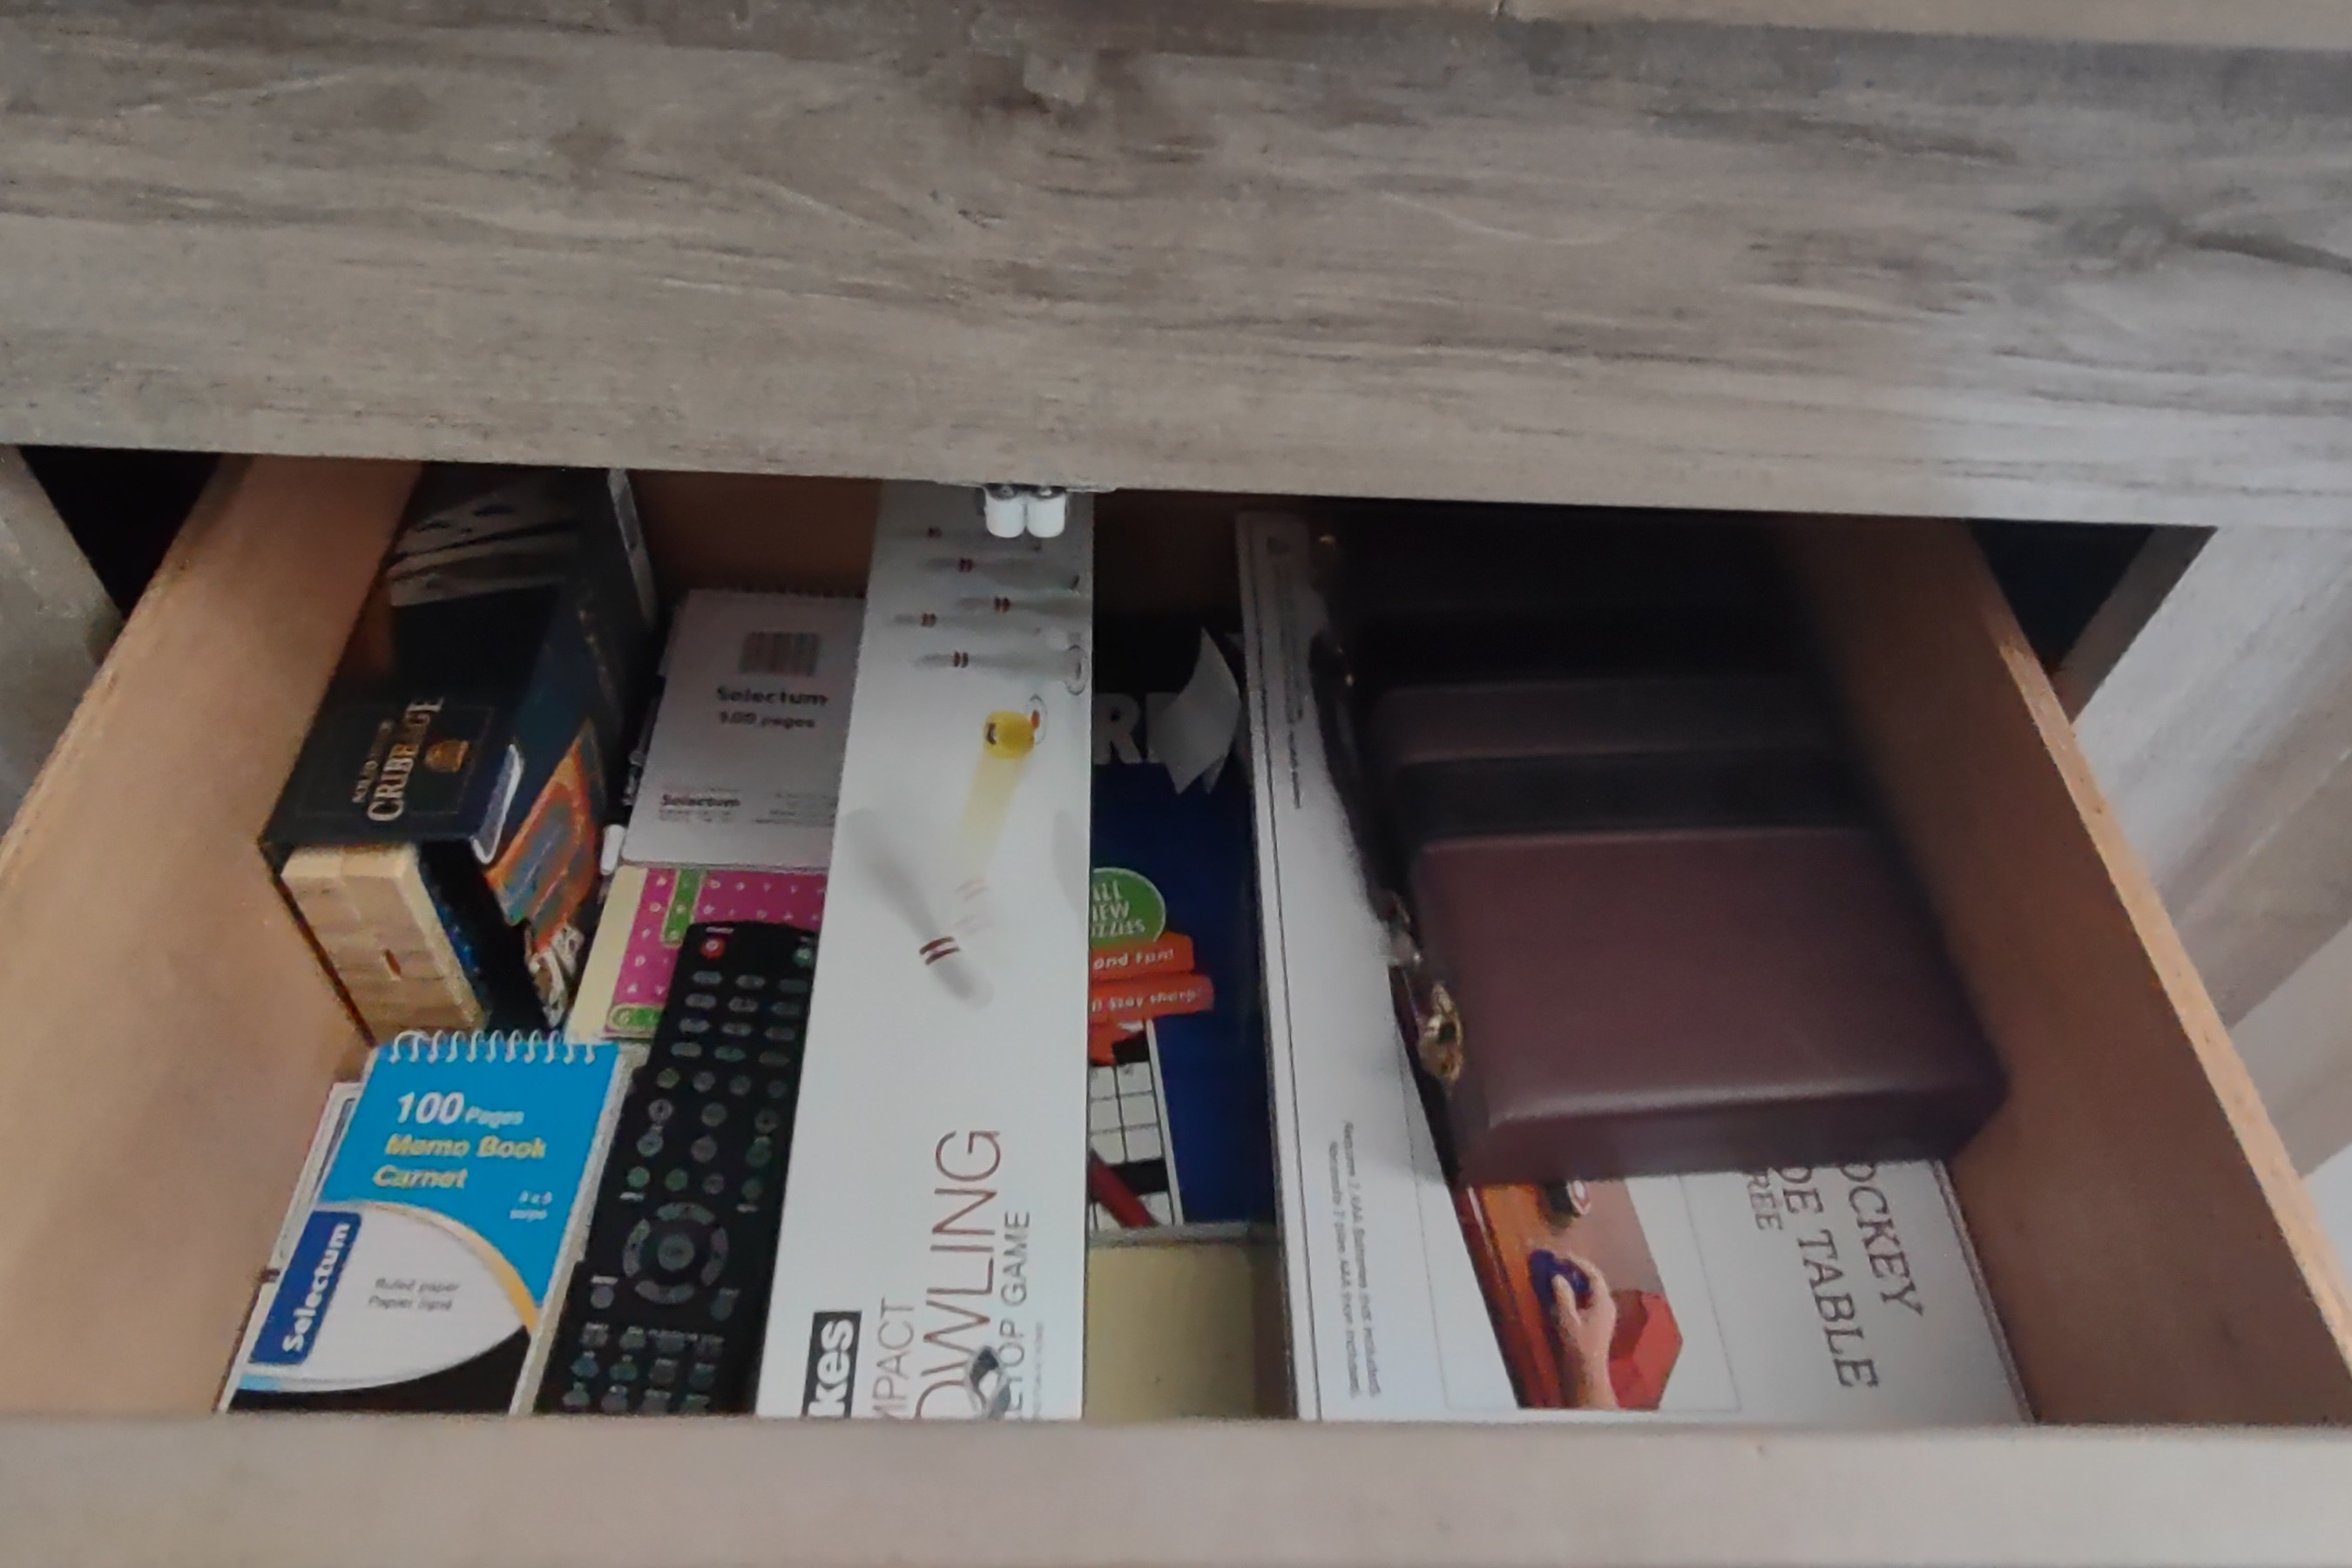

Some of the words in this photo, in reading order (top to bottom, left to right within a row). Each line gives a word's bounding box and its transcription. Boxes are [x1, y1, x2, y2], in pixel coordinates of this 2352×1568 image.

[716, 686, 828, 706] Selectum
[397, 1091, 465, 1125] 100
[464, 1105, 524, 1129] Pages
[384, 1132, 470, 1158] Memo
[476, 1135, 546, 1159] Book
[371, 1164, 469, 1189] Carnet
[999, 1212, 1031, 1307] GAME
[281, 1221, 351, 1353] Selectum
[1795, 1229, 1880, 1388] TABLE
